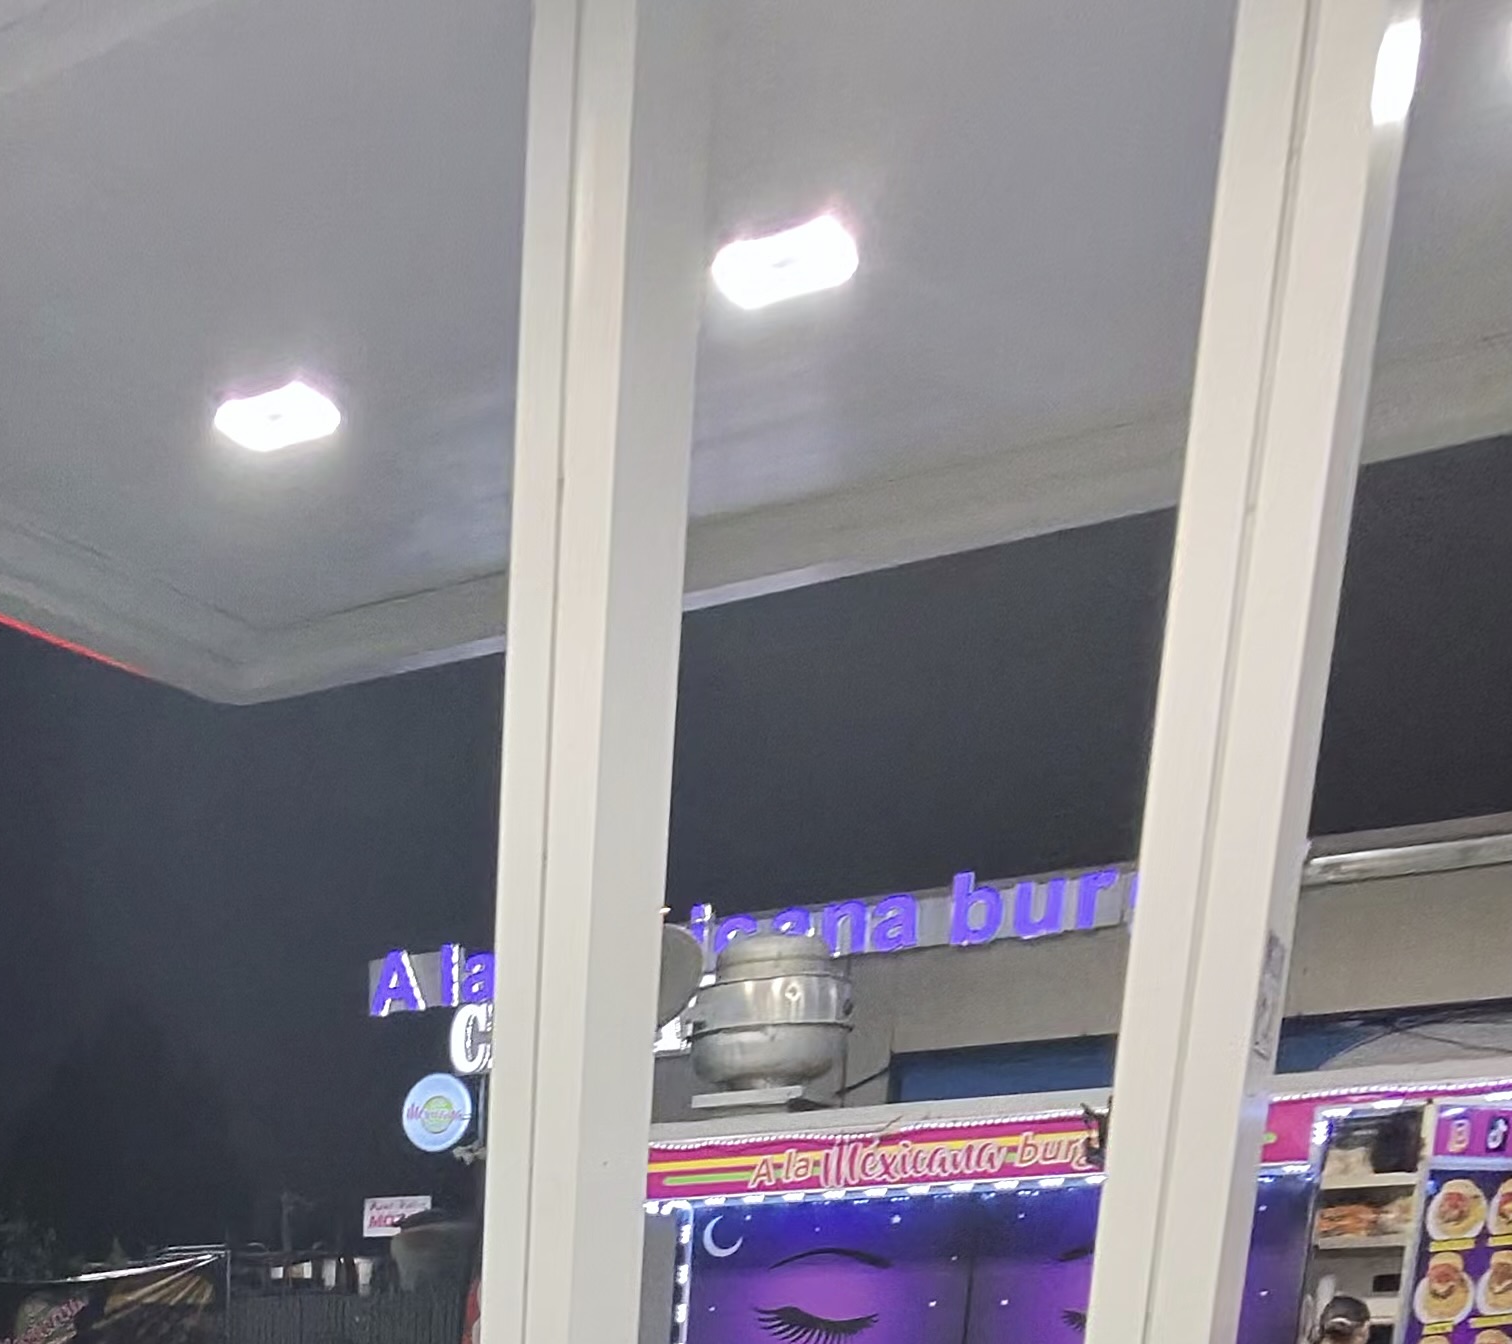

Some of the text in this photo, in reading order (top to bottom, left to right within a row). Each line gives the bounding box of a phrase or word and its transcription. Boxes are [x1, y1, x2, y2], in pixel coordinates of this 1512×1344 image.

[370, 948, 426, 1017] A
[441, 941, 494, 1007] la
[951, 868, 1140, 946] bur
[748, 1155, 775, 1189] A
[783, 1149, 814, 1184] la
